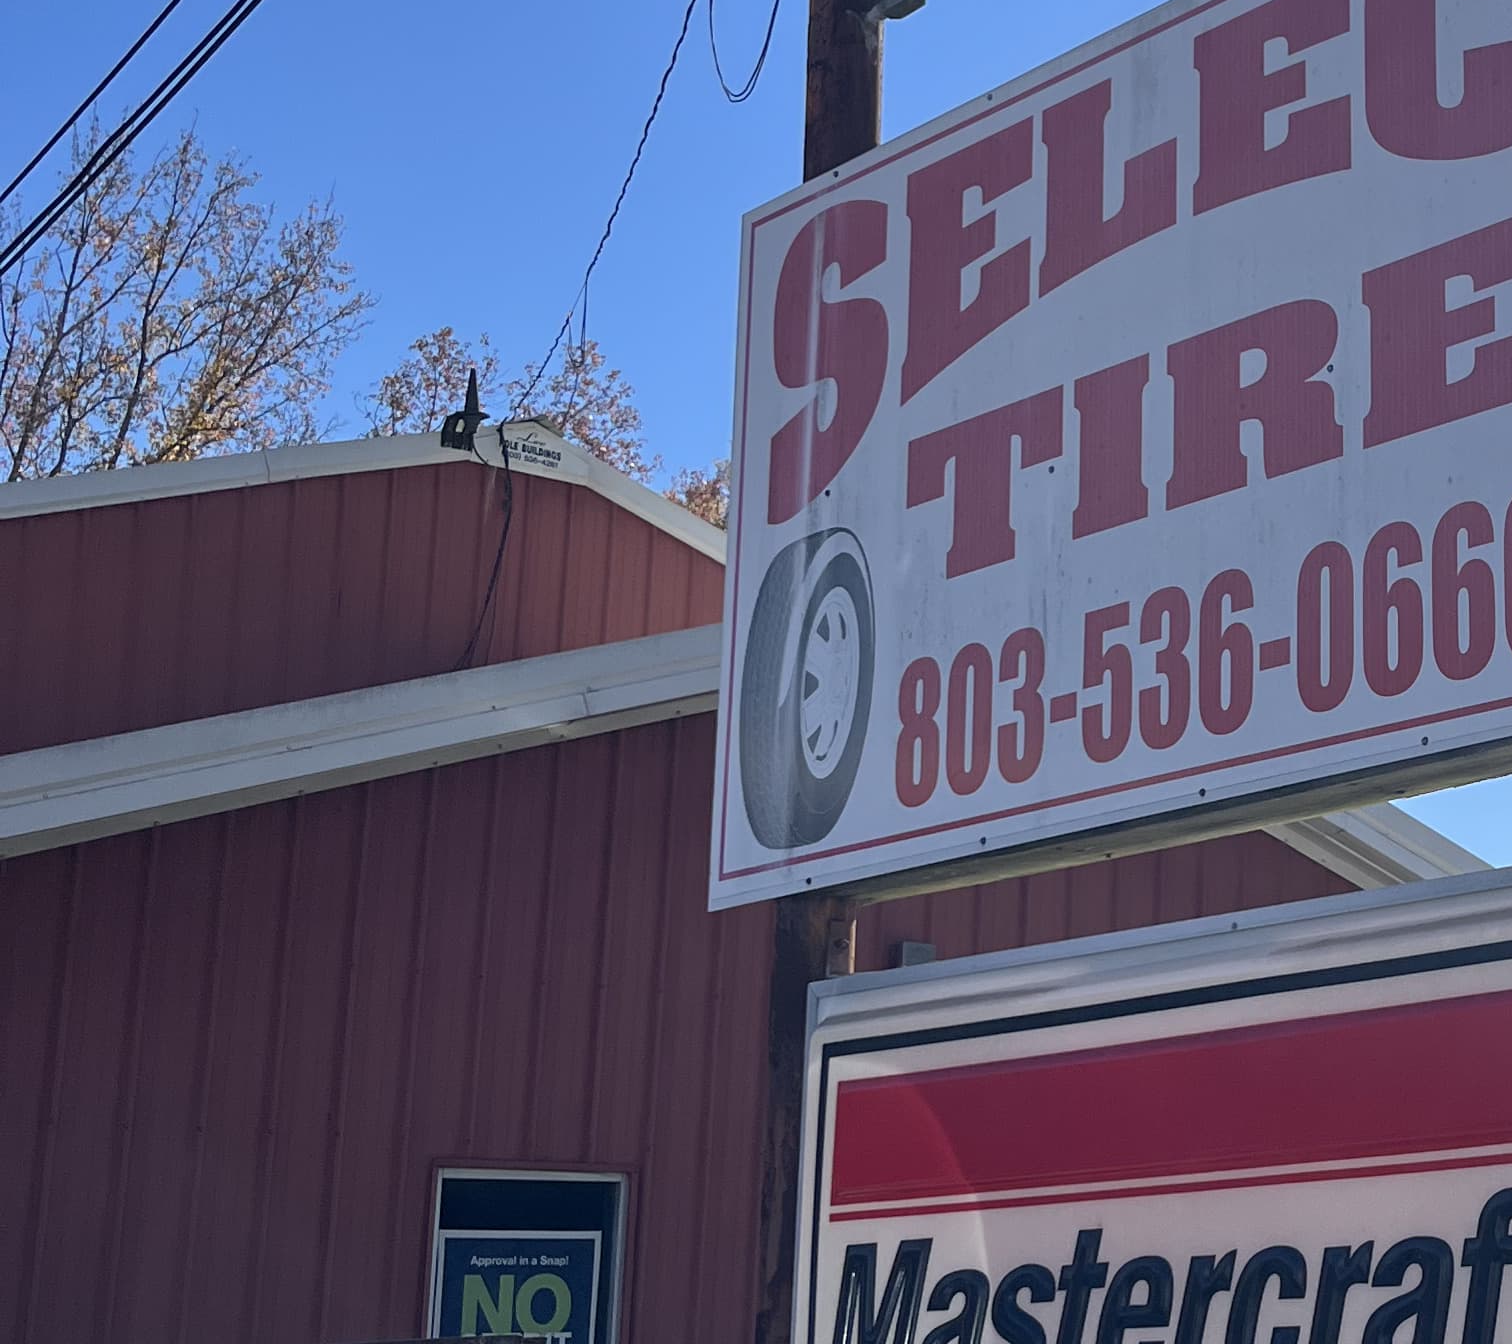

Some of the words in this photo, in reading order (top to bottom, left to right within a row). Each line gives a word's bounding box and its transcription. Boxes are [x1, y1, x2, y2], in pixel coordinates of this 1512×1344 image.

[470, 1256, 517, 1267] Approval
[519, 1256, 530, 1265] in
[540, 1256, 569, 1267] Snap!
[461, 1273, 571, 1334] NO
